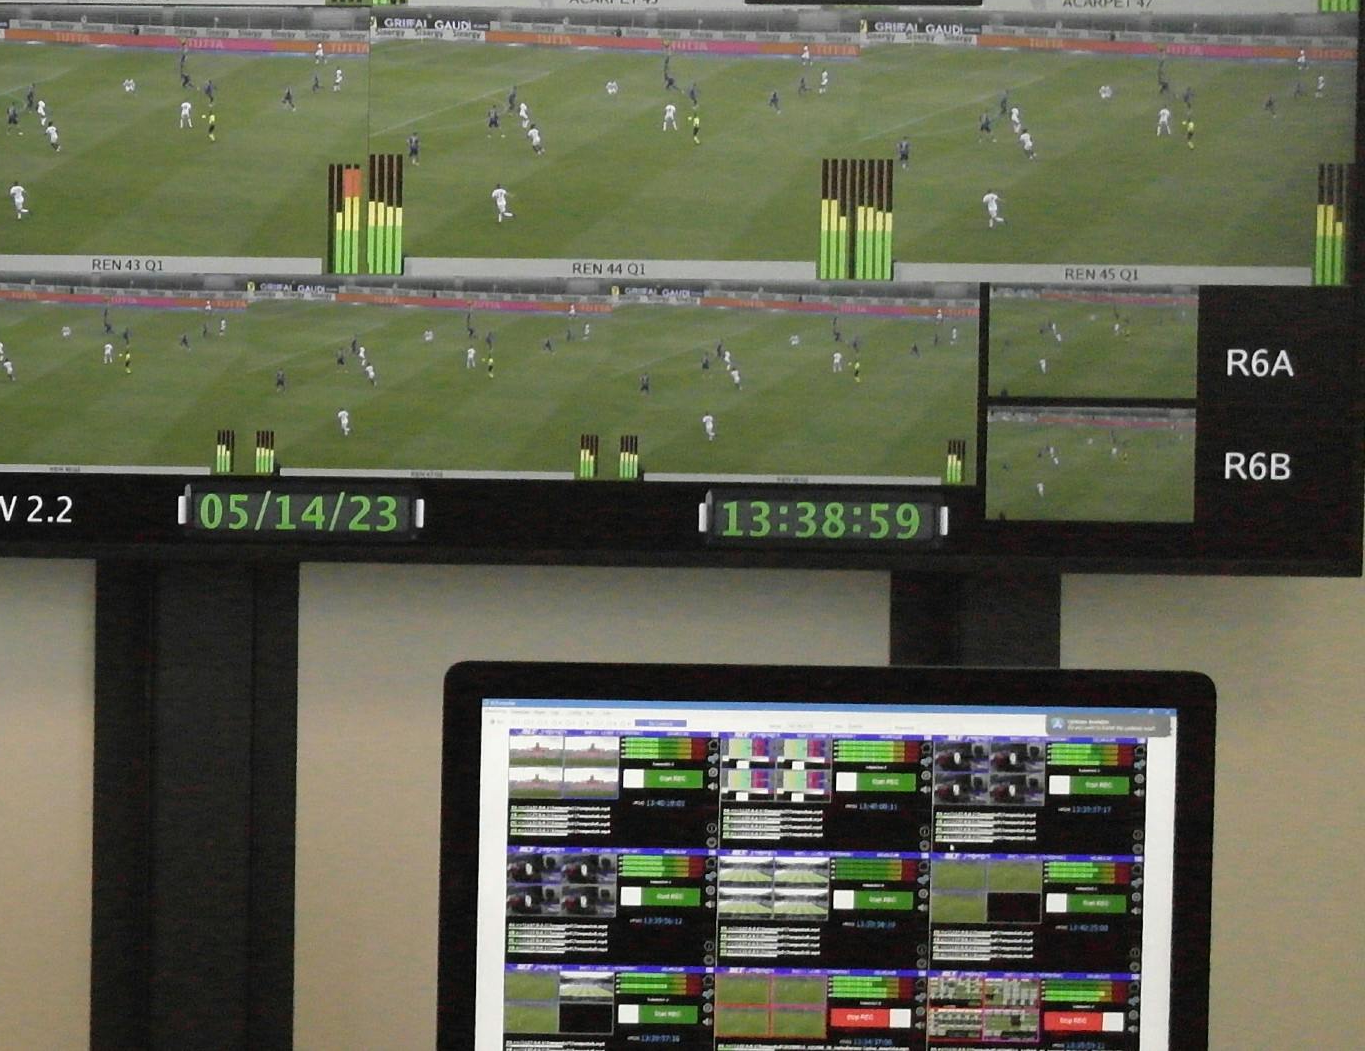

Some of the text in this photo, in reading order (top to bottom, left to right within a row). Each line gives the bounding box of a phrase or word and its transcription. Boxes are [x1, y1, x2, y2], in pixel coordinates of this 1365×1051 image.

[92, 259, 163, 273] REN 43 Q1
[572, 262, 646, 277] REN 44 Q1
[1064, 268, 1138, 282] REN 45 Q1
[1225, 350, 1294, 377] R6A
[1224, 453, 1291, 480] R6B
[25, 496, 73, 523] 2.2
[200, 491, 398, 532] 05/14/23
[722, 501, 921, 540] 13:38:59
